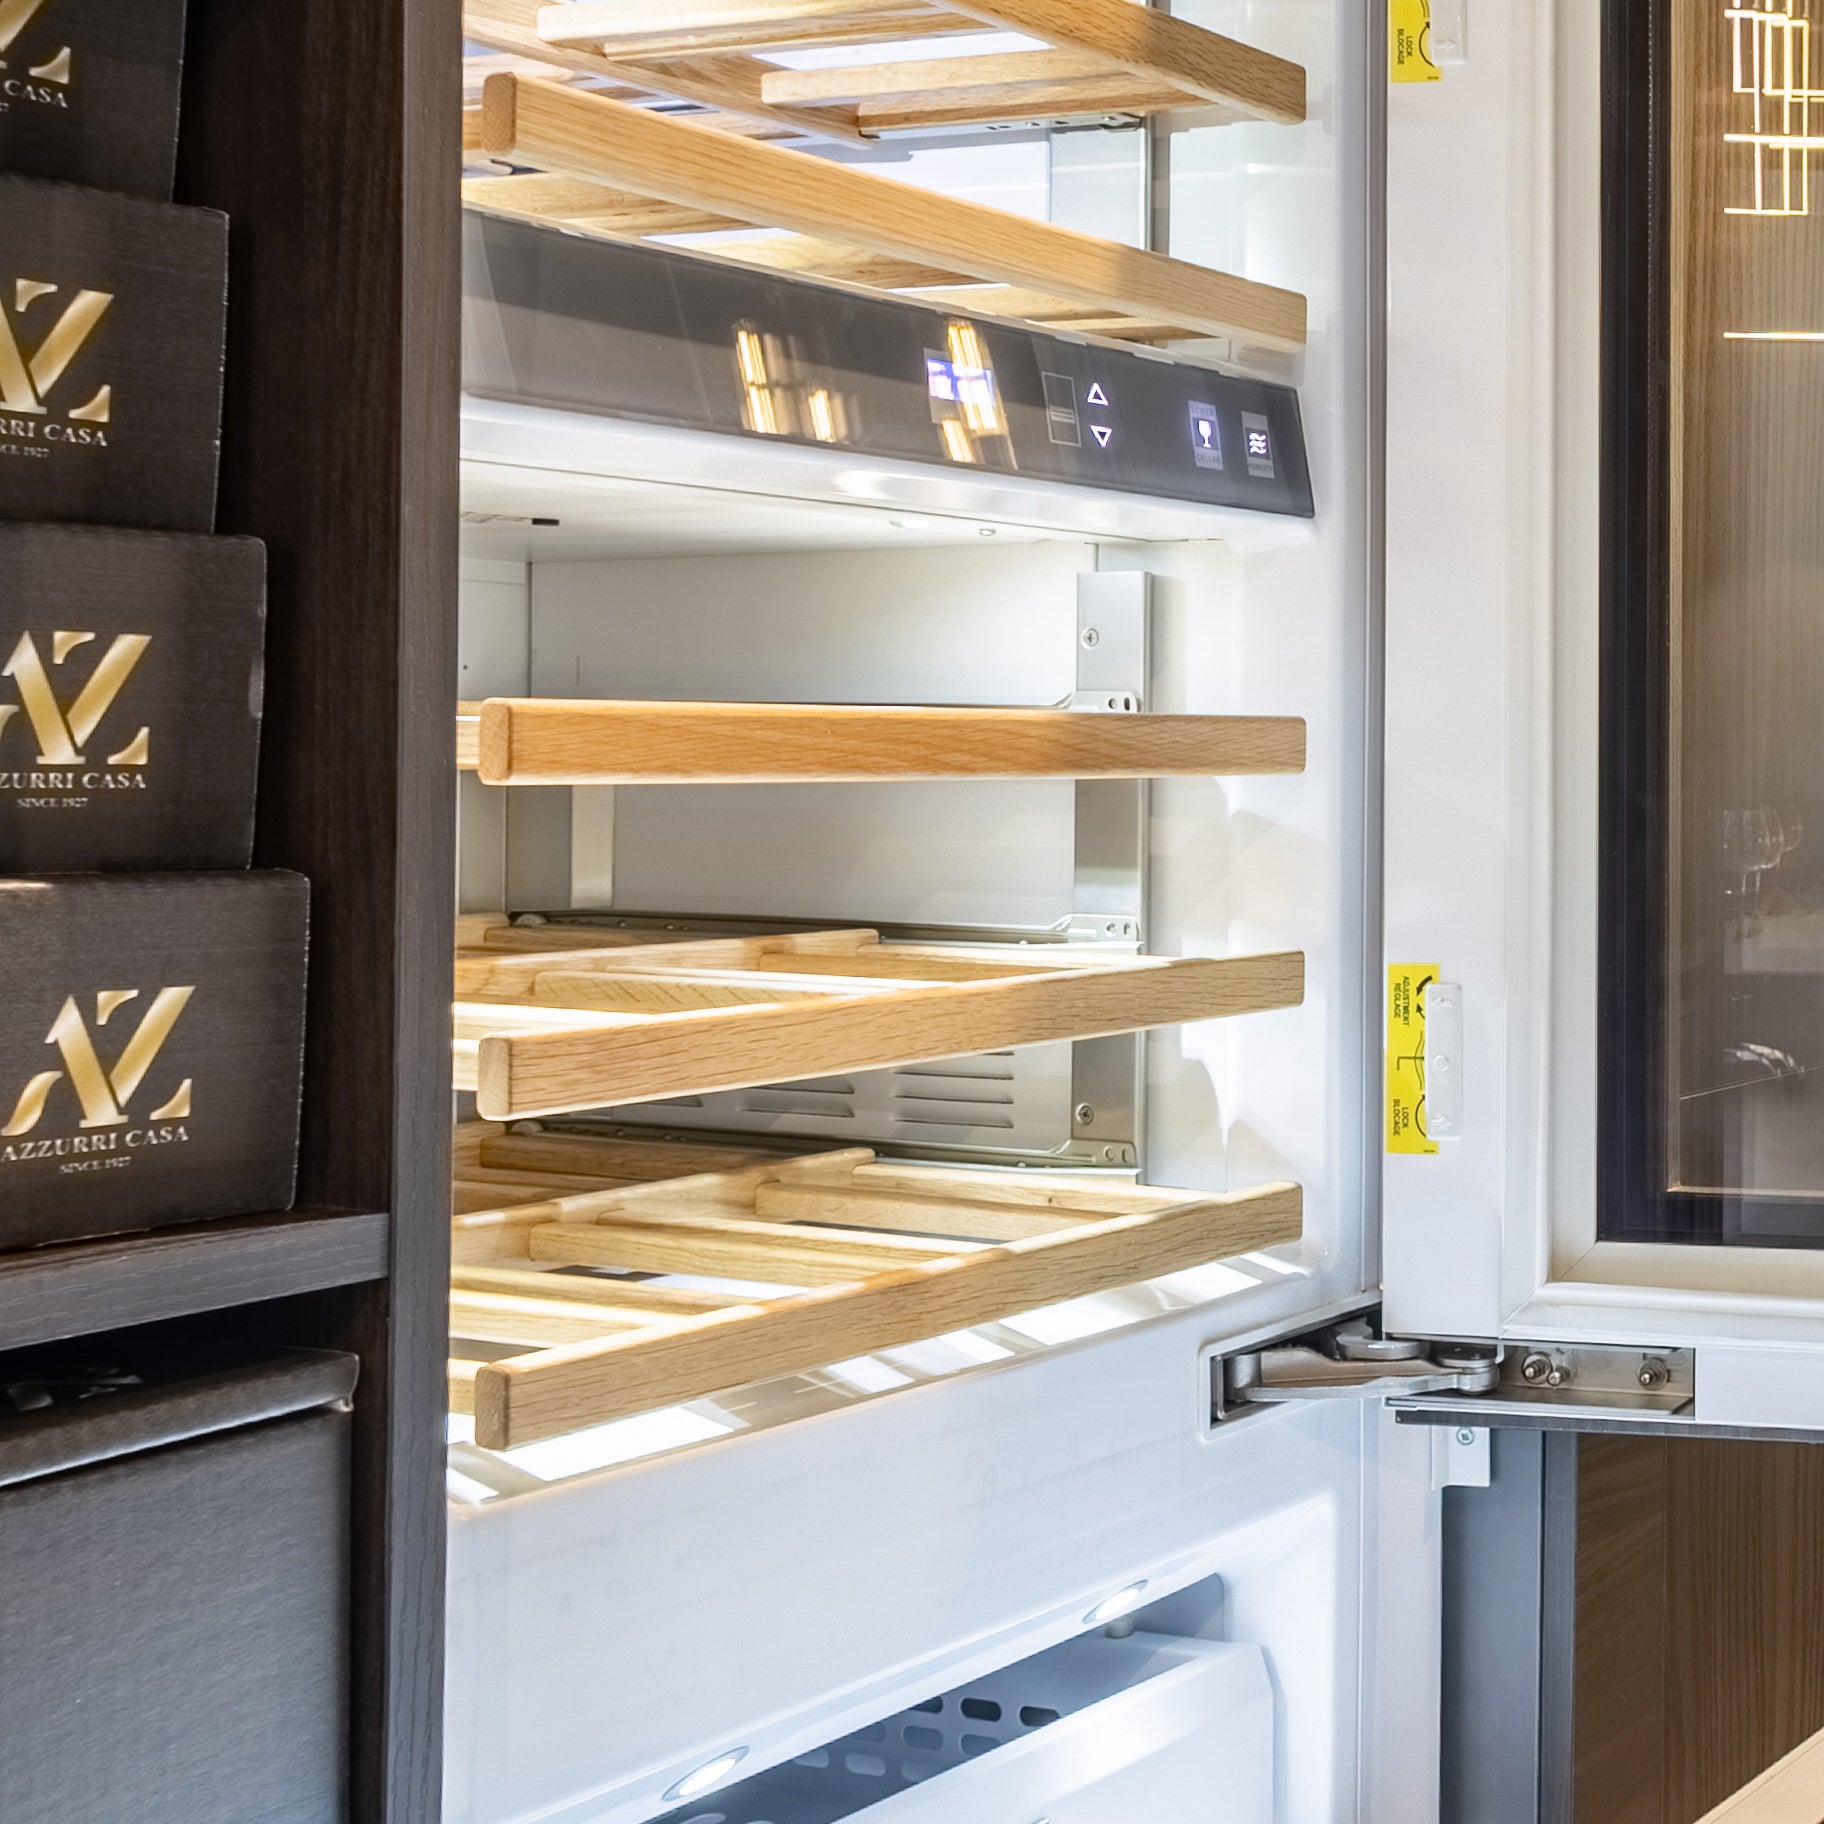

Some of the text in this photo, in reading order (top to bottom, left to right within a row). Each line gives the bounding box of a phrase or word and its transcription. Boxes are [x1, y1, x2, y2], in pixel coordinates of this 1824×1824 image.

[1397, 28, 1405, 66] BLOCAGE
[1405, 35, 1413, 58] LOCK
[4, 79, 70, 109] CASA
[43, 423, 109, 447] CASA
[81, 771, 147, 790] CASA
[16, 796, 59, 809] SINCE
[1402, 975, 1410, 1027] ADJUSTMENT
[0, 985, 196, 1137] AZ
[1393, 1098, 1401, 1137] BLOCAGE
[1401, 1106, 1409, 1129] LOCK
[1, 1125, 190, 1162] AZZURRI CASA
[59, 1158, 104, 1175] SINCE
